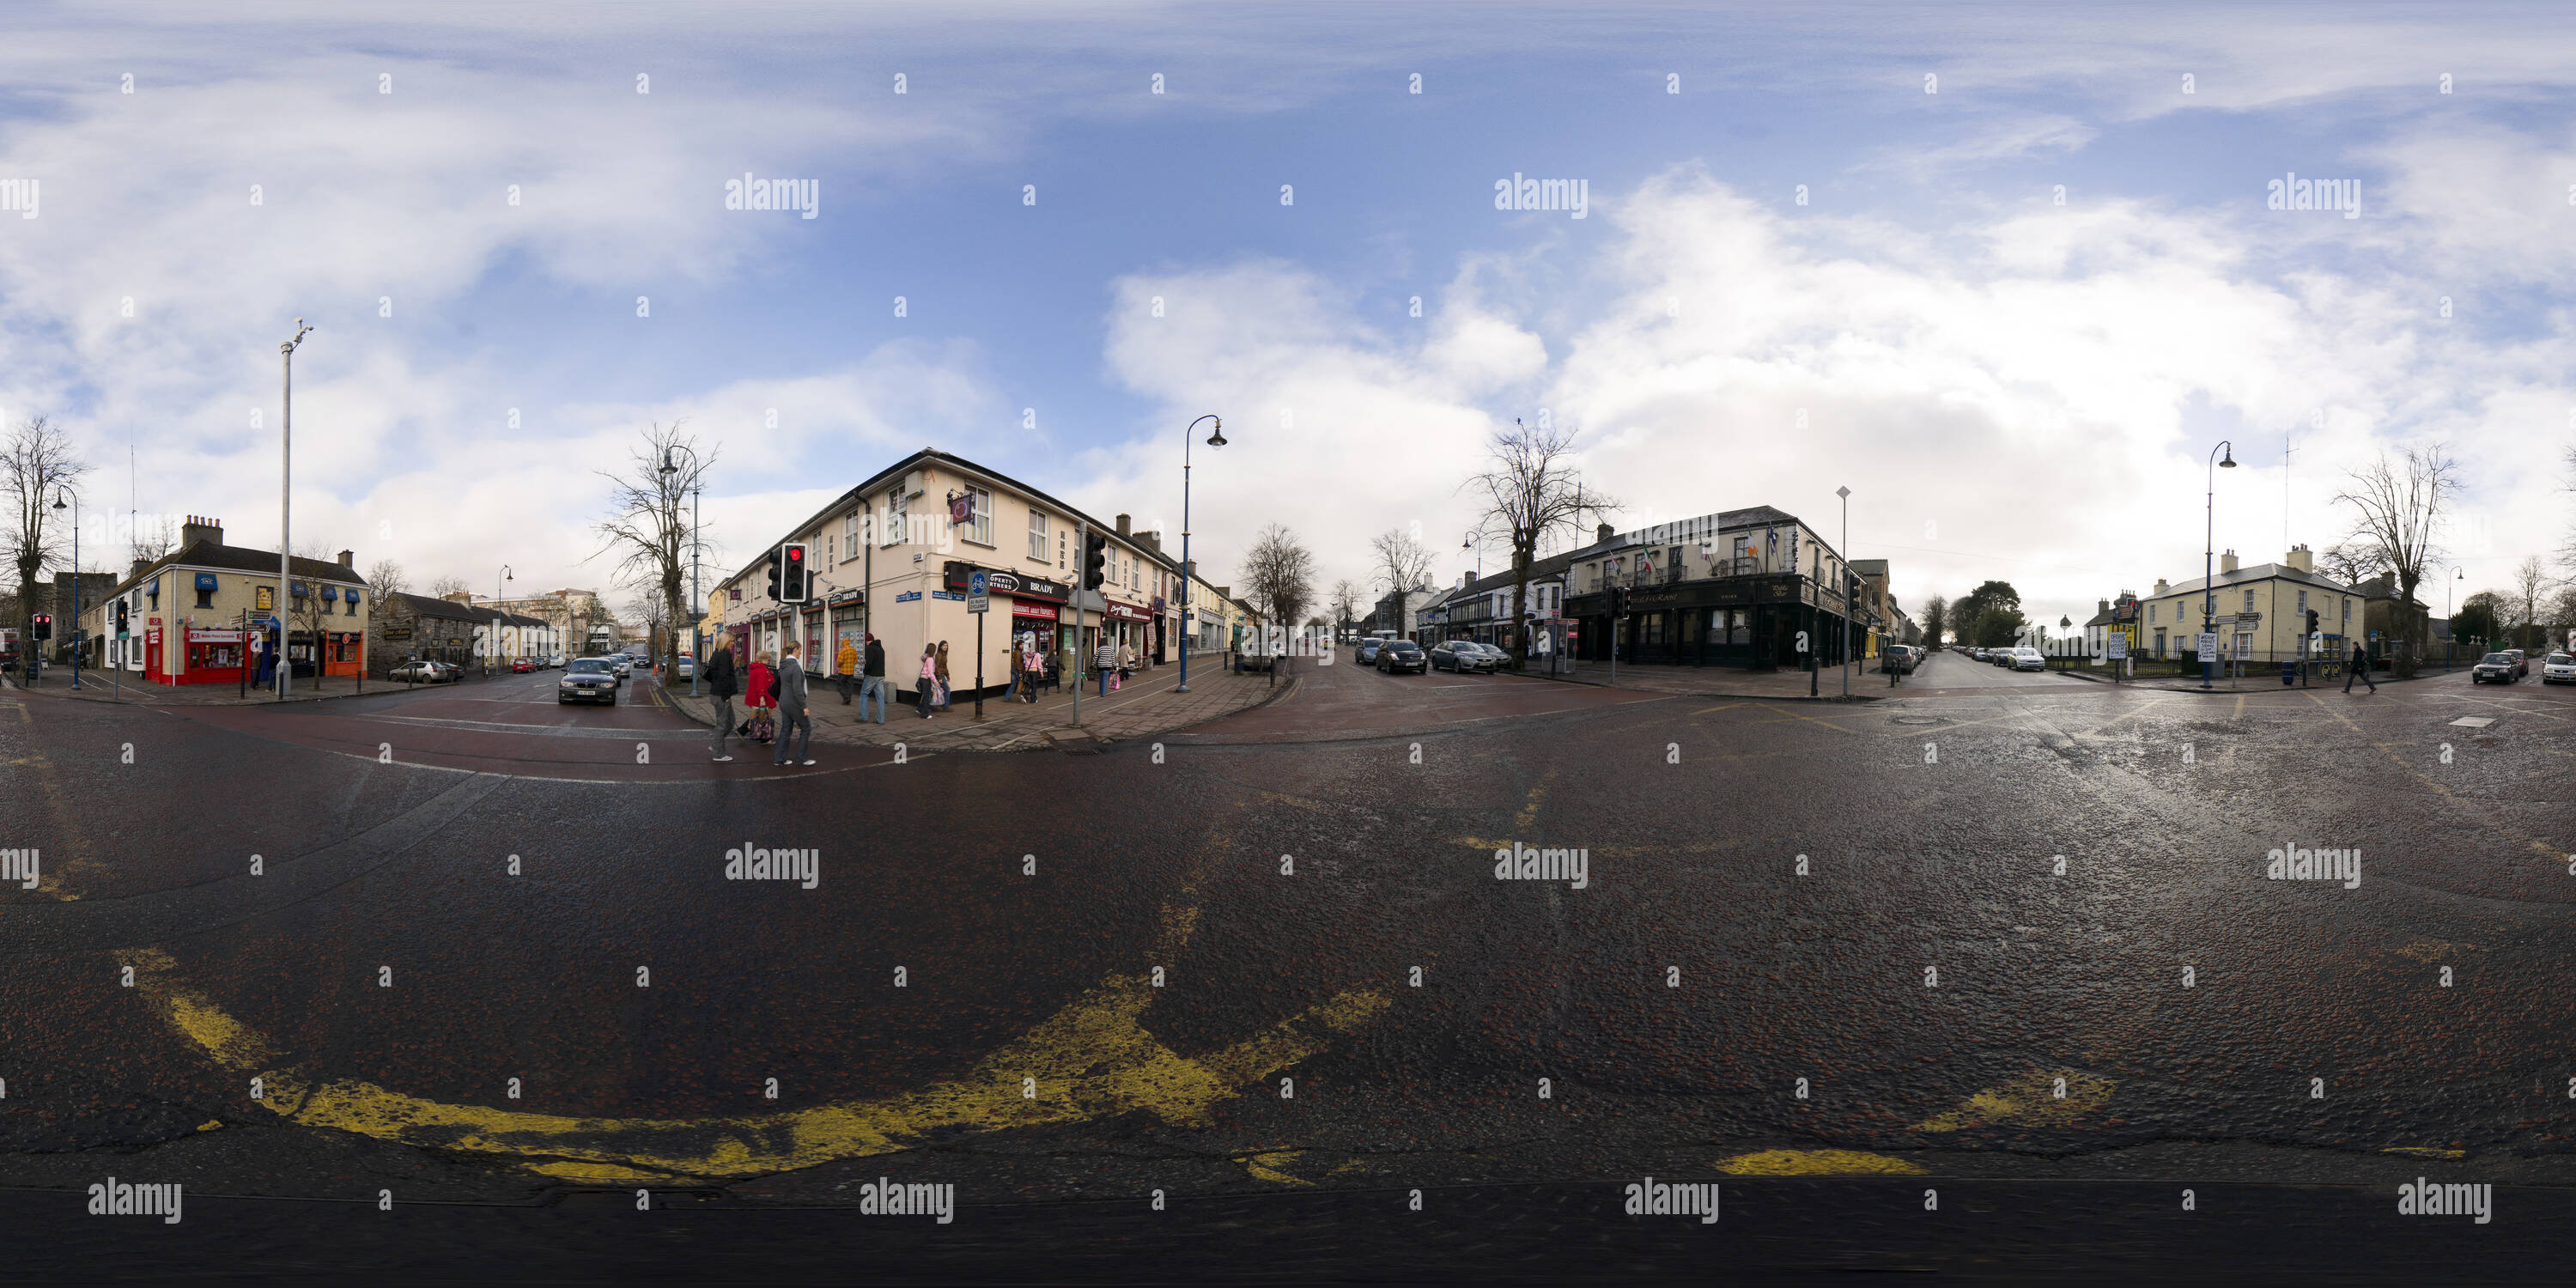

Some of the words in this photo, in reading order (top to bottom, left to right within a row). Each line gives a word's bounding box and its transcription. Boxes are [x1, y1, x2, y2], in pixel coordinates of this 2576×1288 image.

[990, 576, 1012, 585] OPERTY
[1030, 582, 1054, 593] BRADY
[843, 591, 858, 600] BRADY
